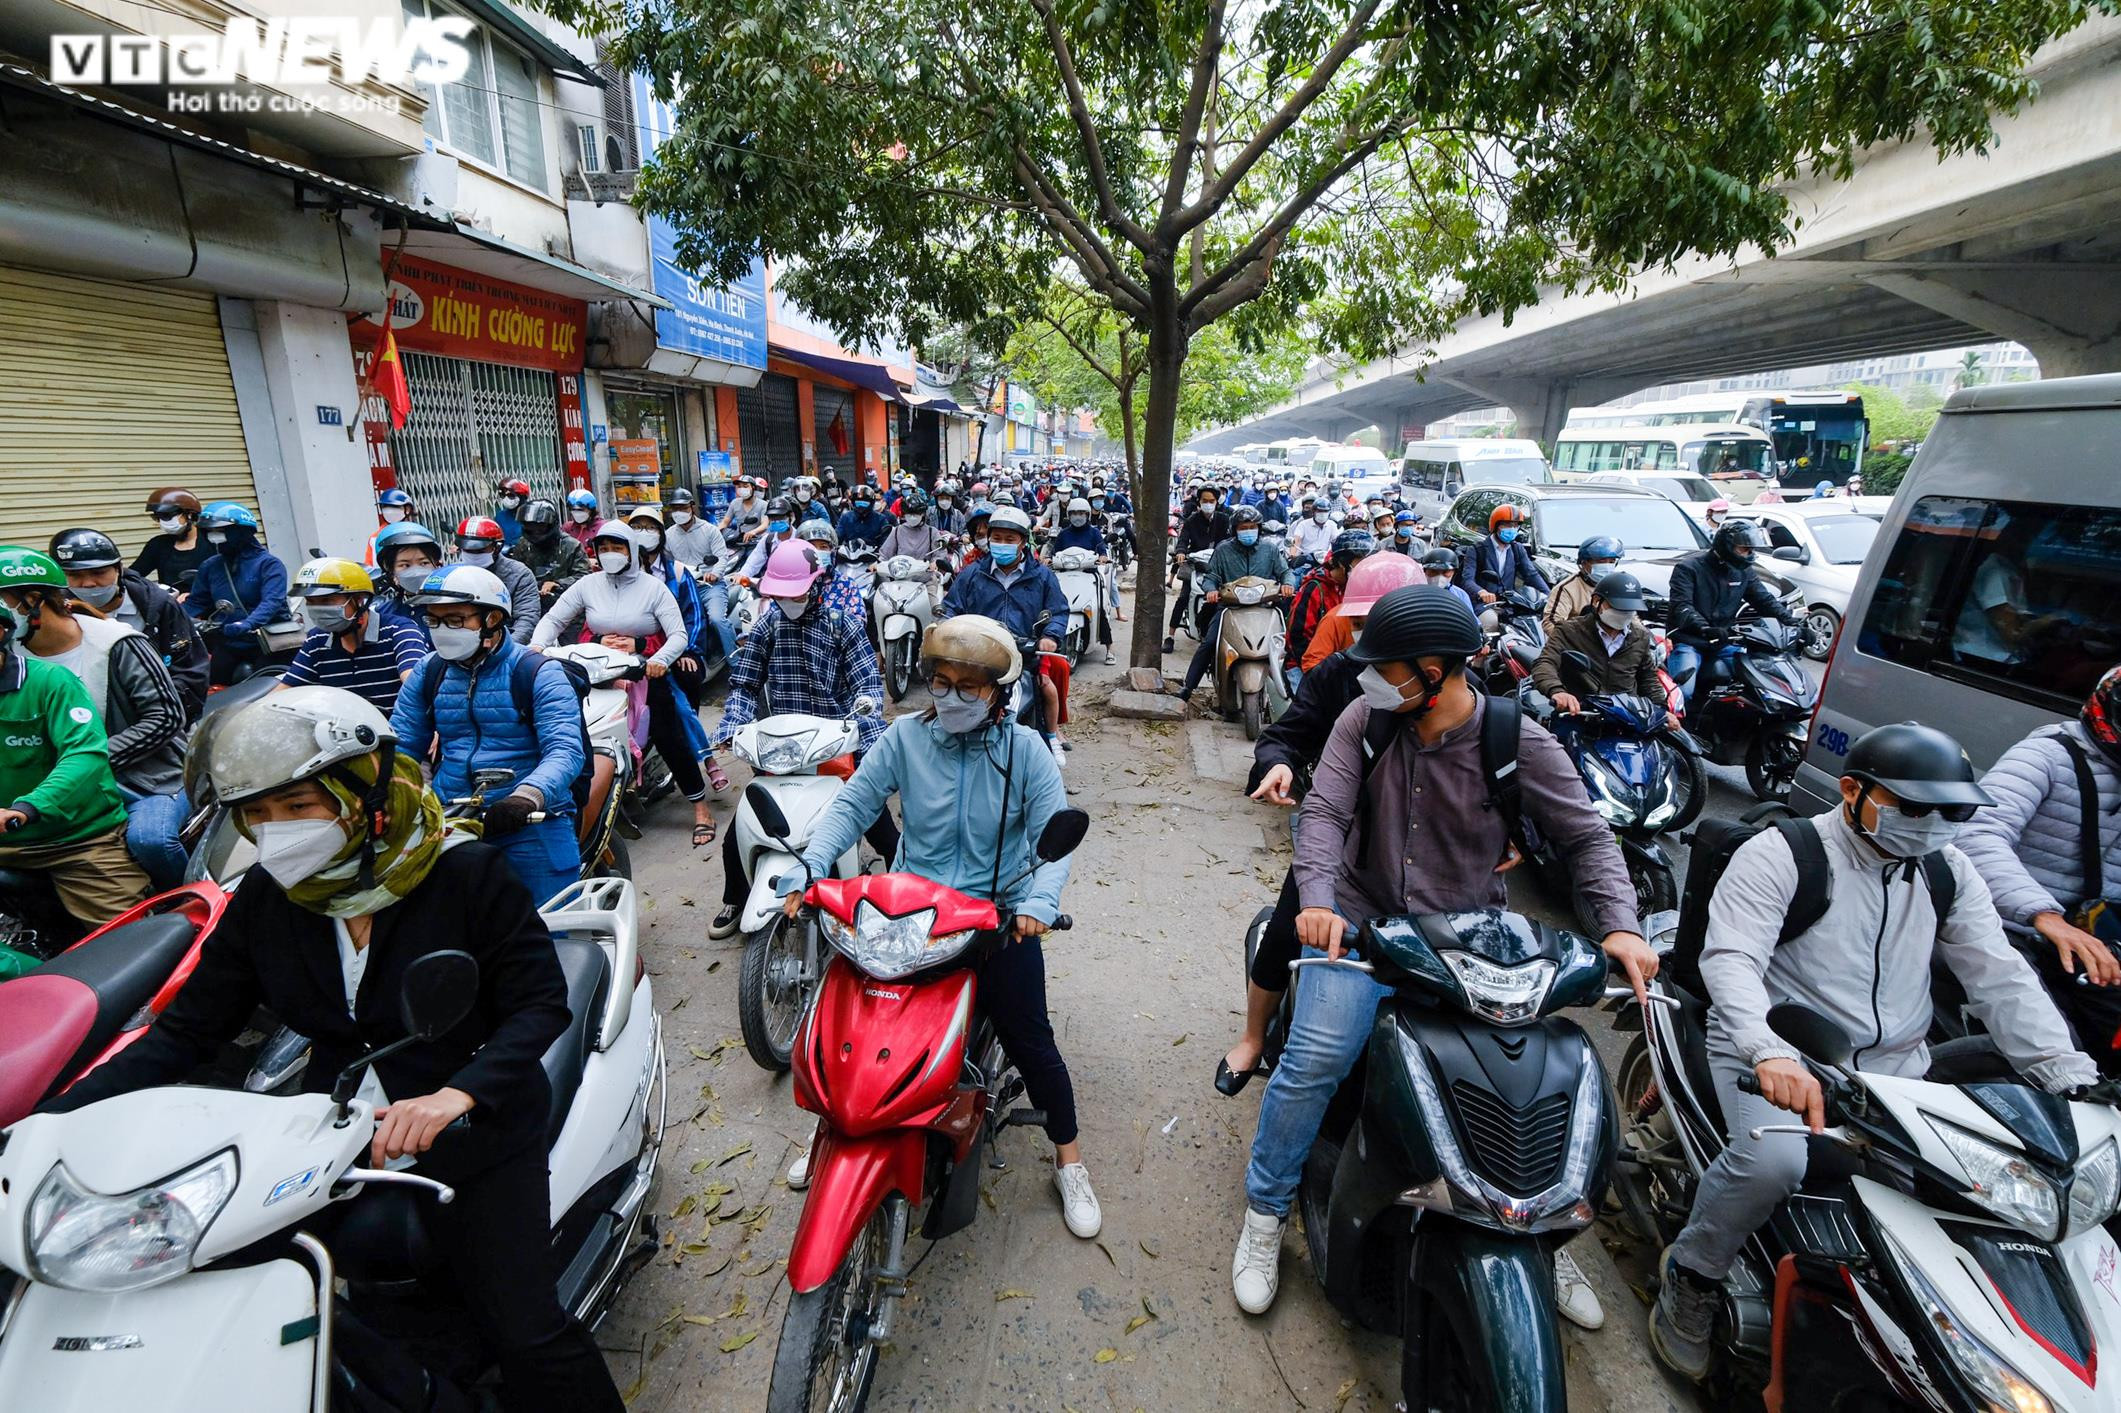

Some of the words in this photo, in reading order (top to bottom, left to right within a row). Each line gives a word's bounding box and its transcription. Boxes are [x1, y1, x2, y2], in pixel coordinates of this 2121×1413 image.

[386, 292, 419, 320] HẤT
[431, 290, 481, 341] KÍNH
[488, 305, 545, 349] CƯỜNG
[551, 321, 577, 359] LỰC
[561, 375, 577, 396] 179
[319, 408, 340, 423] 177
[2, 563, 47, 578] Grab
[5, 735, 44, 747] Grab
[865, 987, 901, 1000] HONDA
[1997, 1242, 2053, 1258] HONDA
